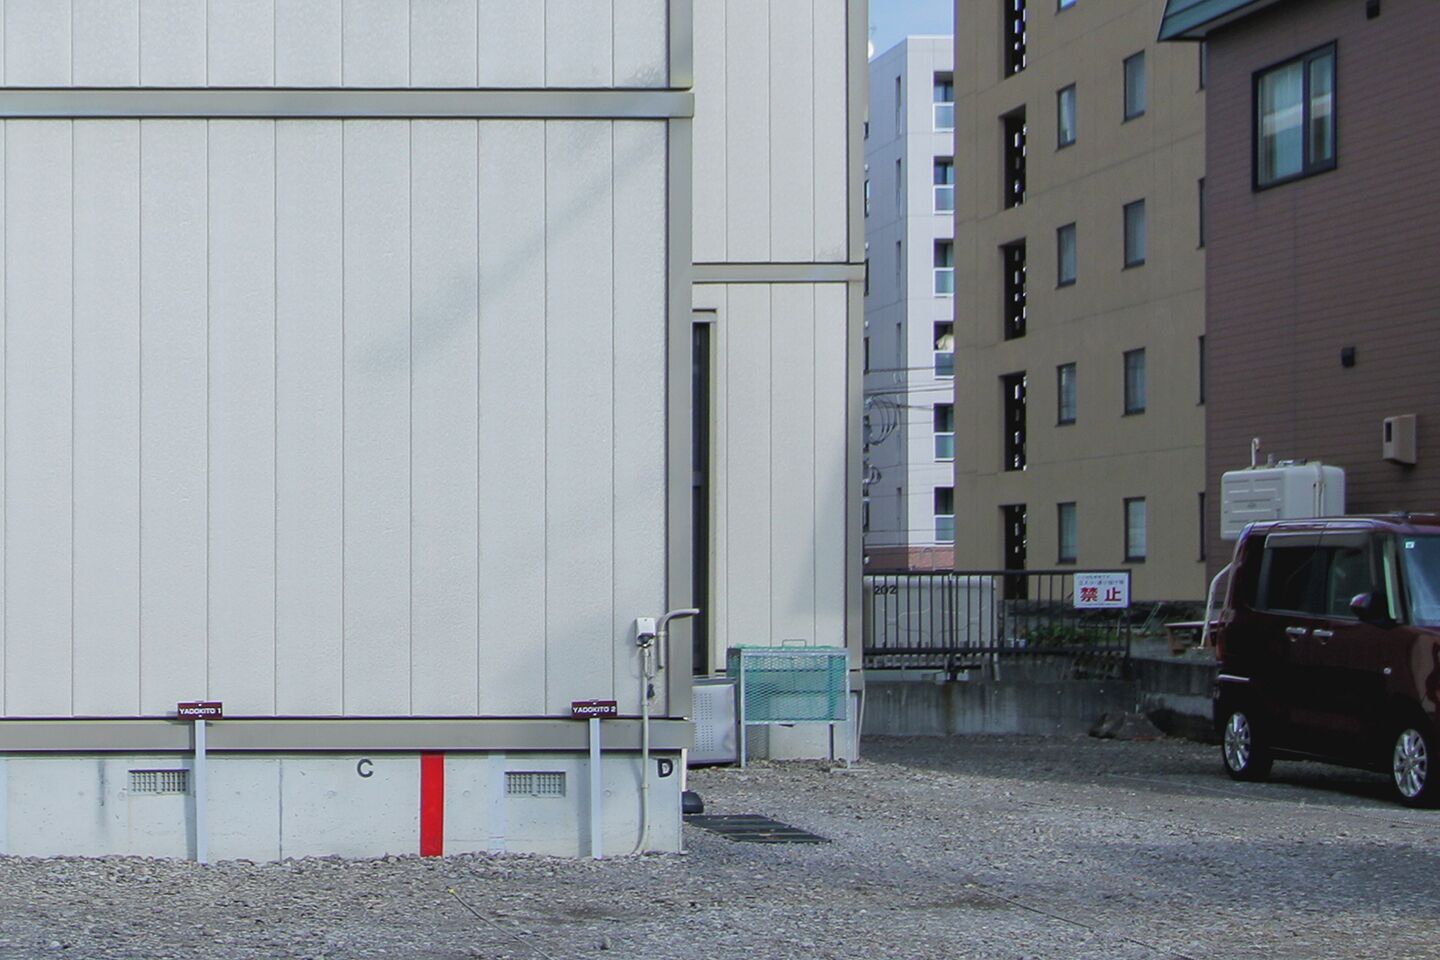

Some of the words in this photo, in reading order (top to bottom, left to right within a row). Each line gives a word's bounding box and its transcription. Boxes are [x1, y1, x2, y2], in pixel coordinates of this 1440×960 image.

[873, 585, 897, 595] 202
[1079, 586, 1122, 602] 禁止
[356, 758, 374, 778] C
[657, 758, 673, 778] D
